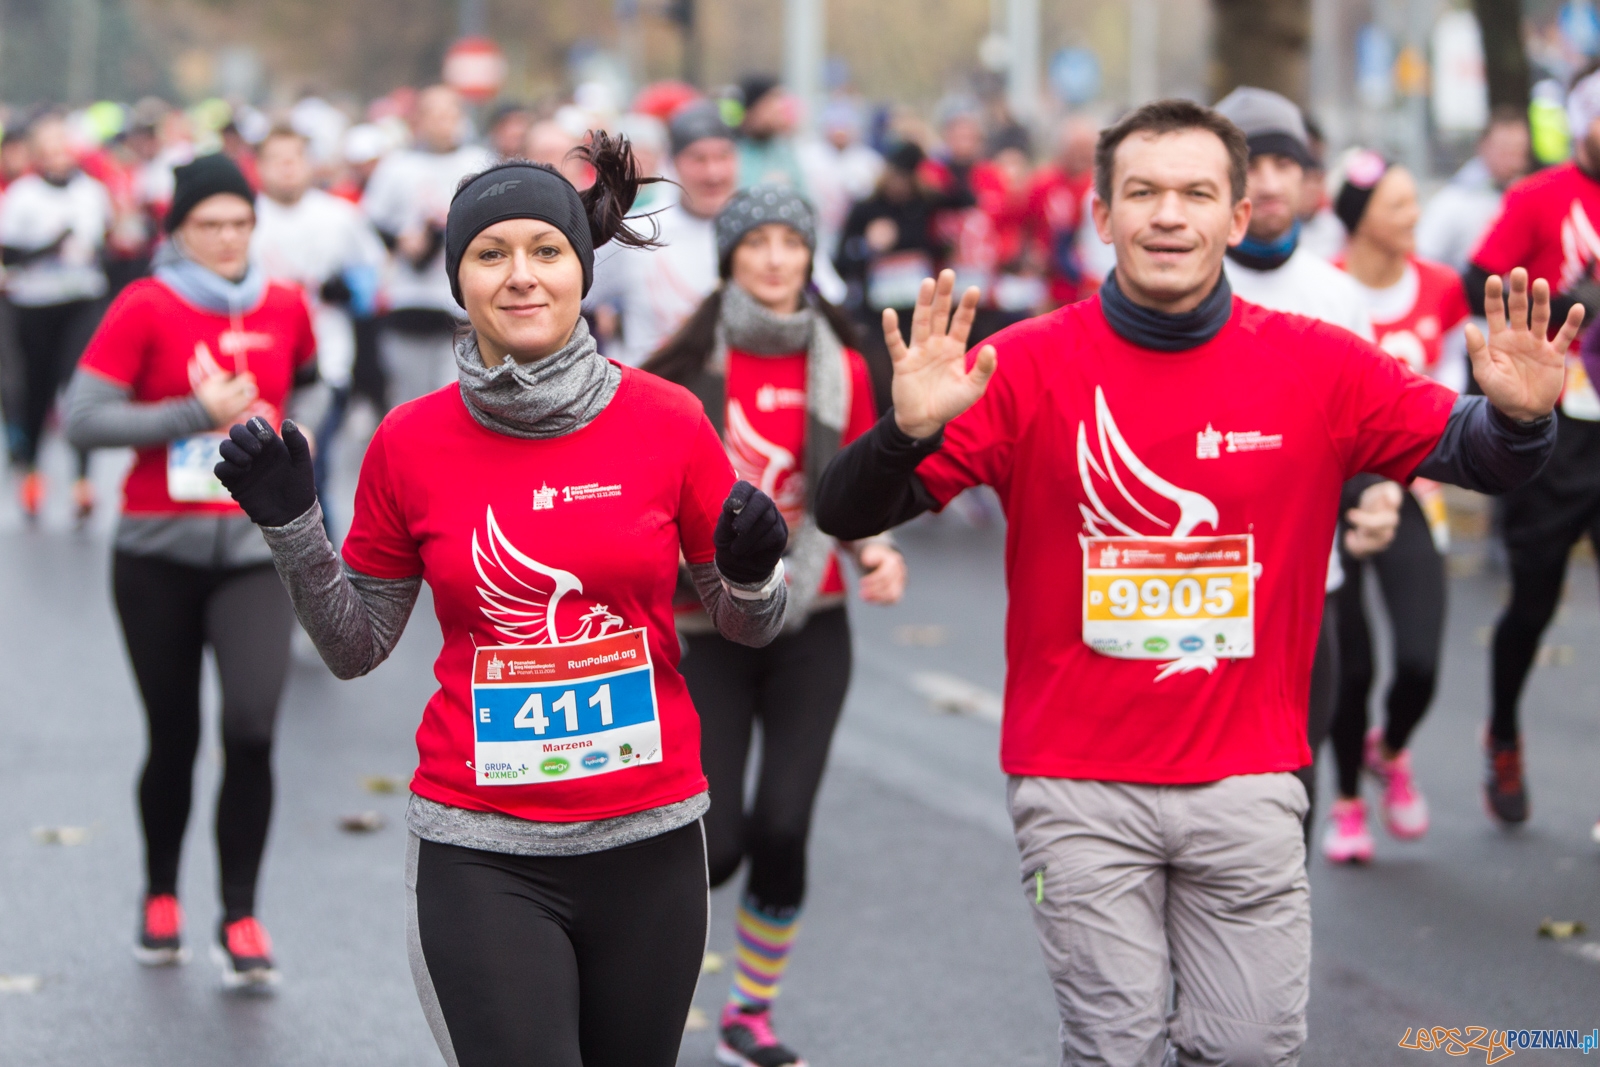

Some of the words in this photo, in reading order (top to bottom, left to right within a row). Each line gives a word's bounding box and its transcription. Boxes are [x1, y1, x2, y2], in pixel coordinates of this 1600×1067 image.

[562, 486, 573, 502] 1
[1175, 550, 1241, 563] RunPoland.org
[1107, 577, 1235, 618] 9905
[567, 649, 637, 670] RunPoland.org
[507, 660, 516, 675] 1
[479, 708, 491, 723] E
[513, 683, 613, 735] 411
[542, 739, 593, 753] Marzena
[484, 763, 512, 771] GRUPA
